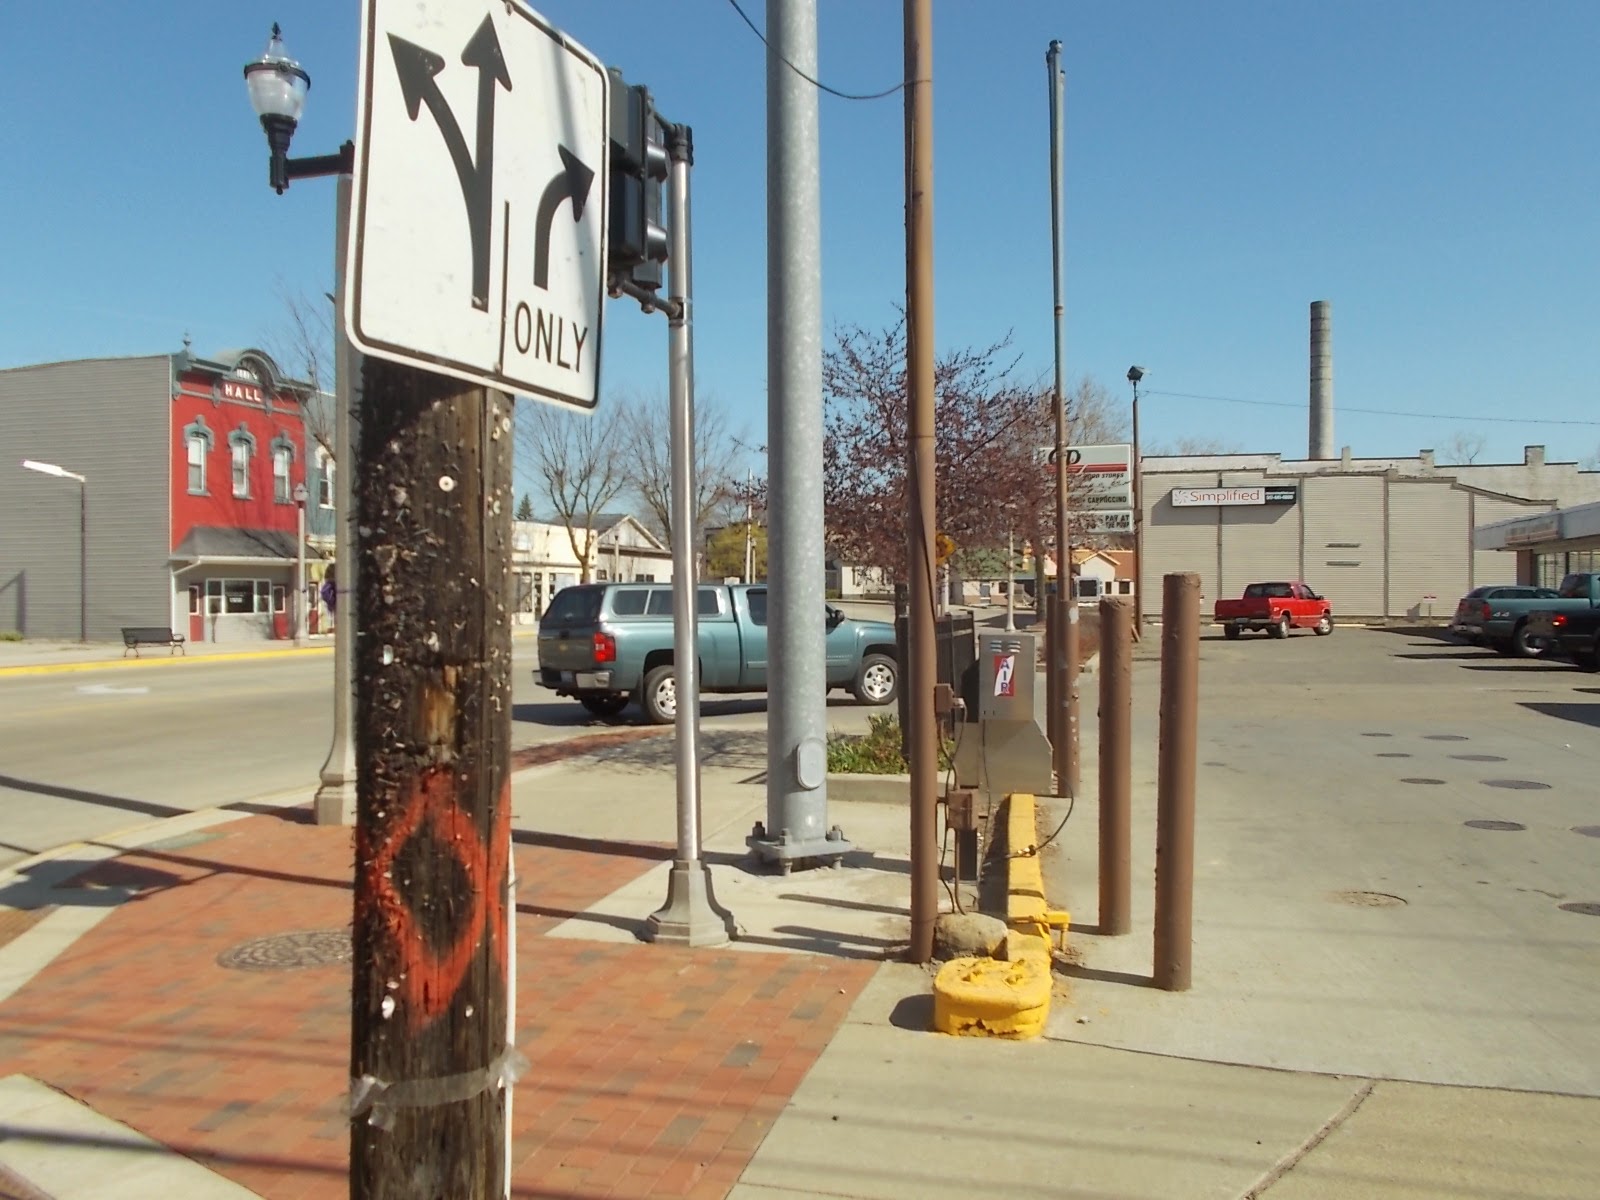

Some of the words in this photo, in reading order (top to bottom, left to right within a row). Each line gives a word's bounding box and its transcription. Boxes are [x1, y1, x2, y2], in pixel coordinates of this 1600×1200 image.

[514, 300, 588, 373] ONLY
[225, 384, 261, 402] HALL
[1087, 495, 1127, 504] CAPPUCCINO
[1190, 489, 1260, 504] Simplified
[1105, 514, 1118, 522] PAY
[1121, 514, 1130, 522] AT
[1000, 658, 1010, 694] AIR
